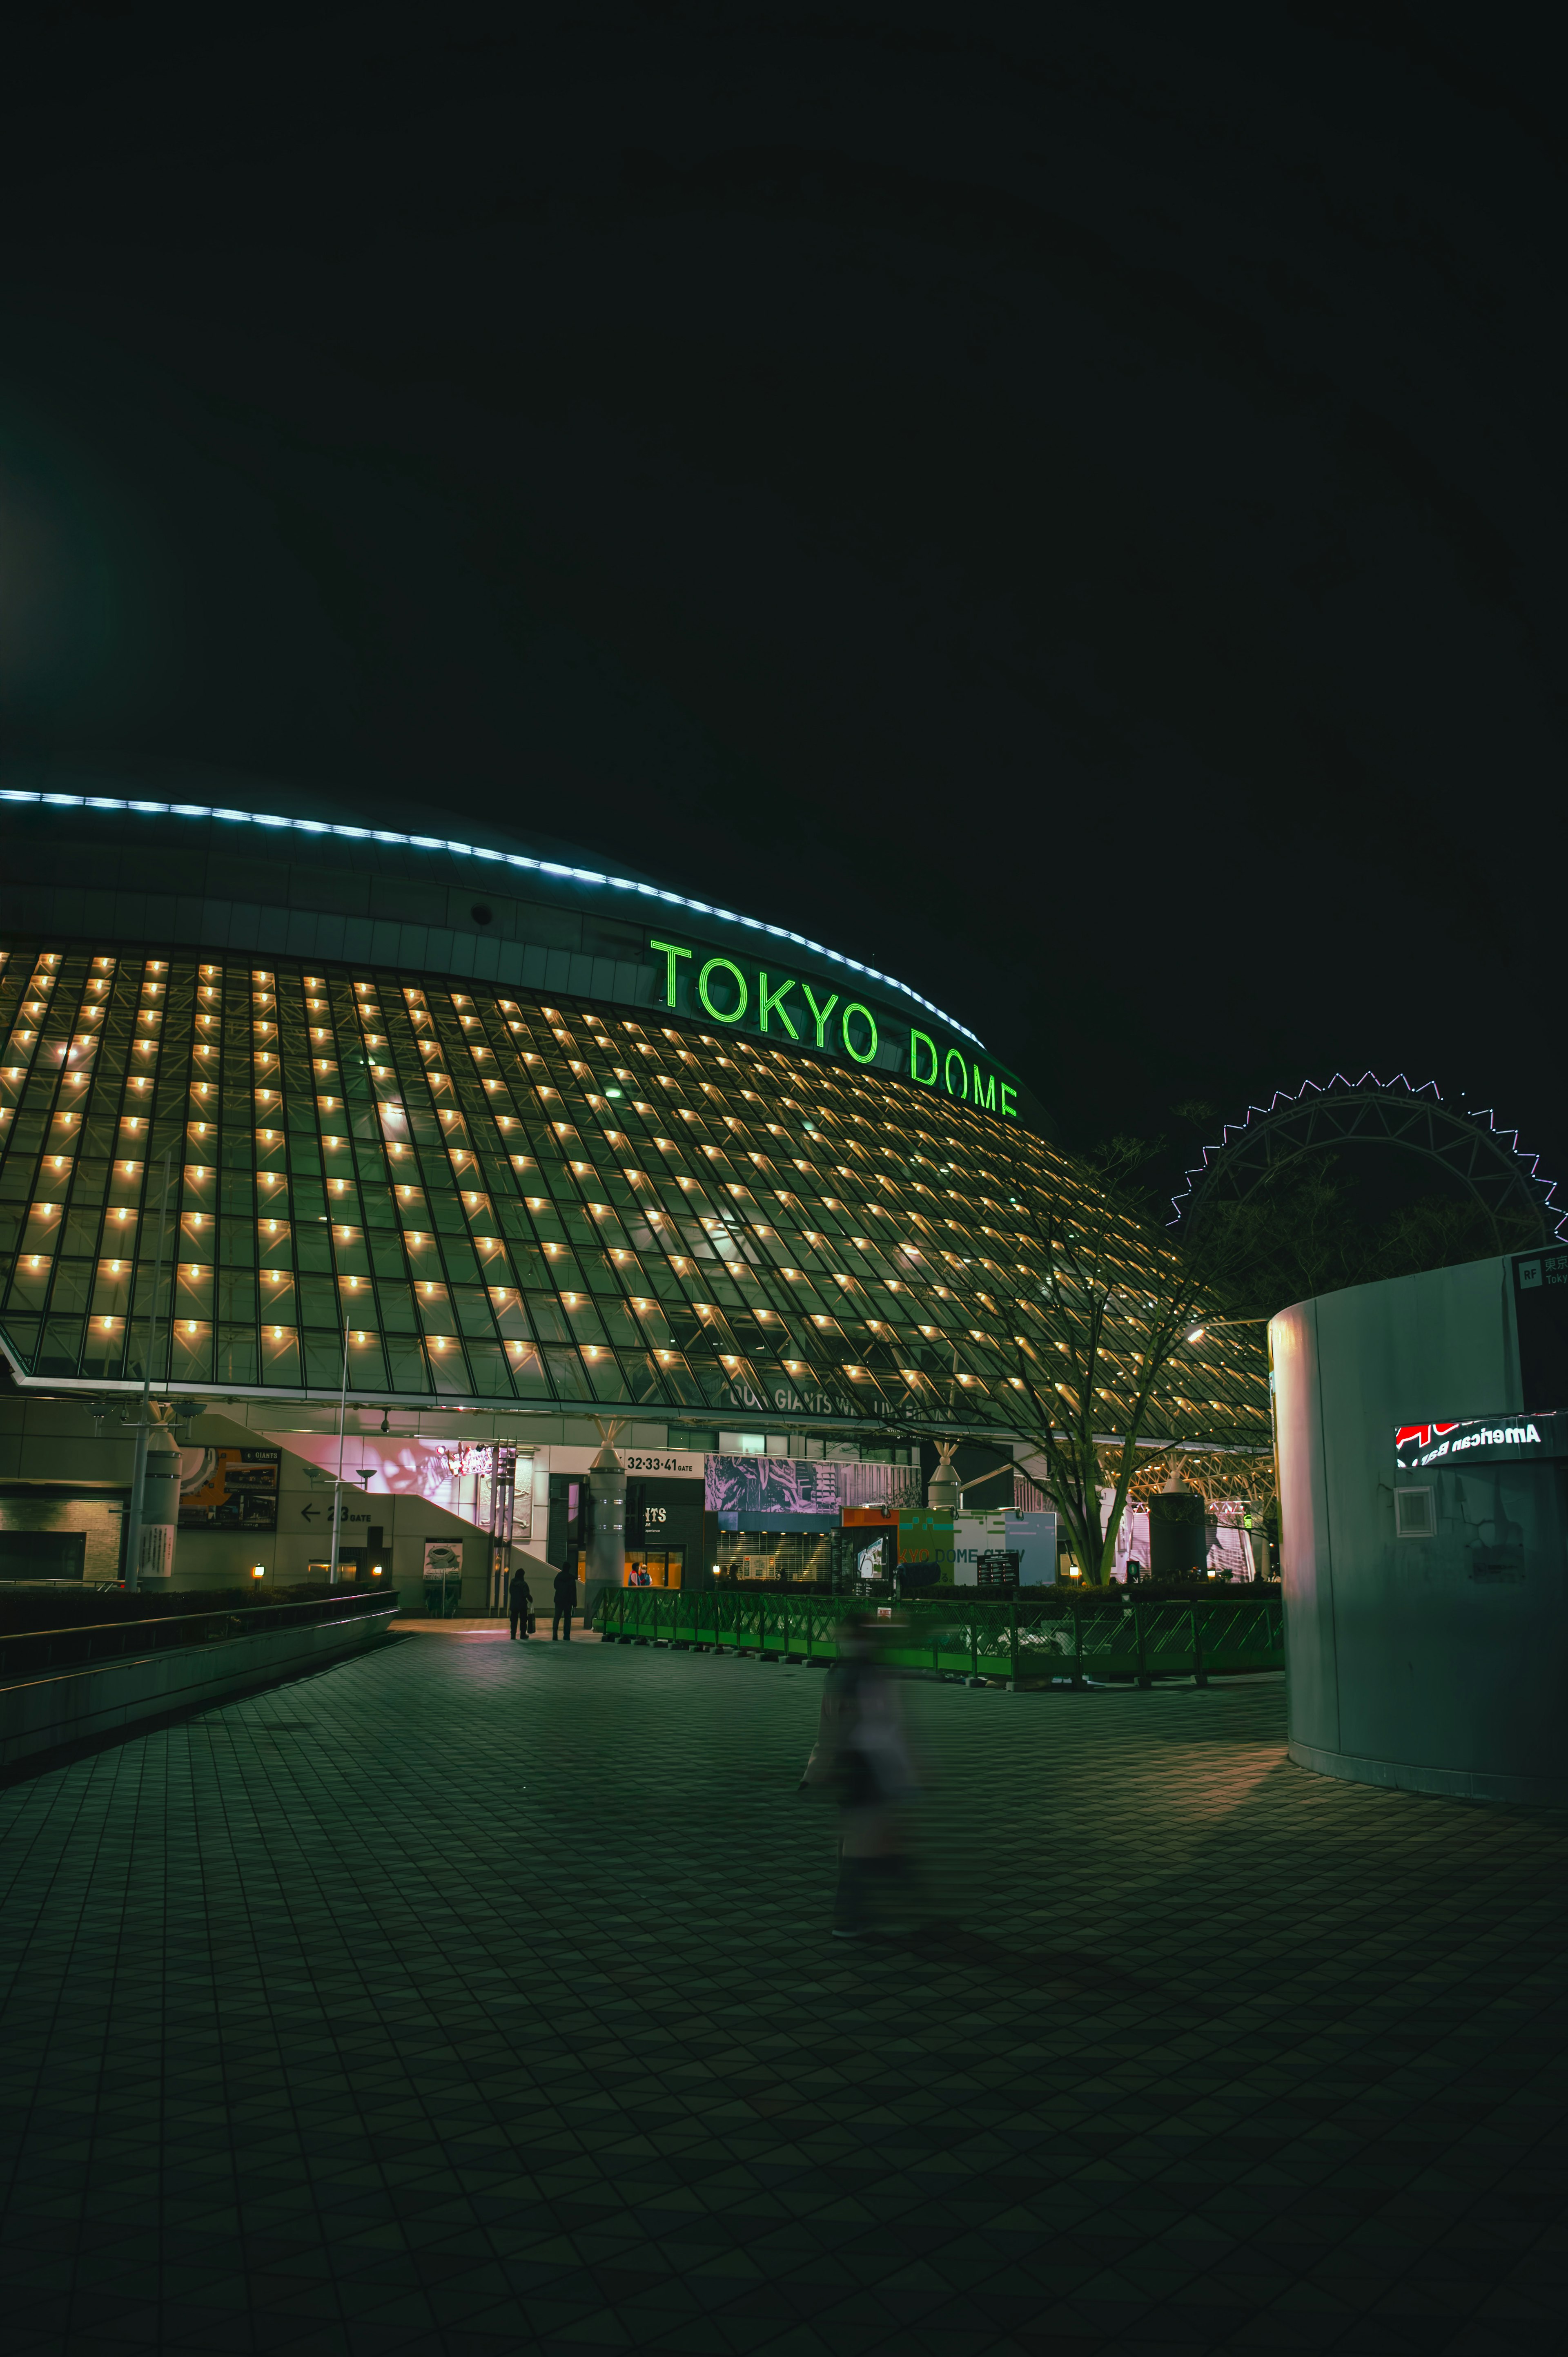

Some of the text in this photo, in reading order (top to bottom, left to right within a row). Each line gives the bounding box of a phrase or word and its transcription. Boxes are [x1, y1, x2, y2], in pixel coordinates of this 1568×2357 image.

[650, 940, 1017, 1117] TOKYO DOME
[1524, 1269, 1537, 1280] RF
[775, 1389, 832, 1414] GIANTS
[935, 1549, 978, 1563] DOME
